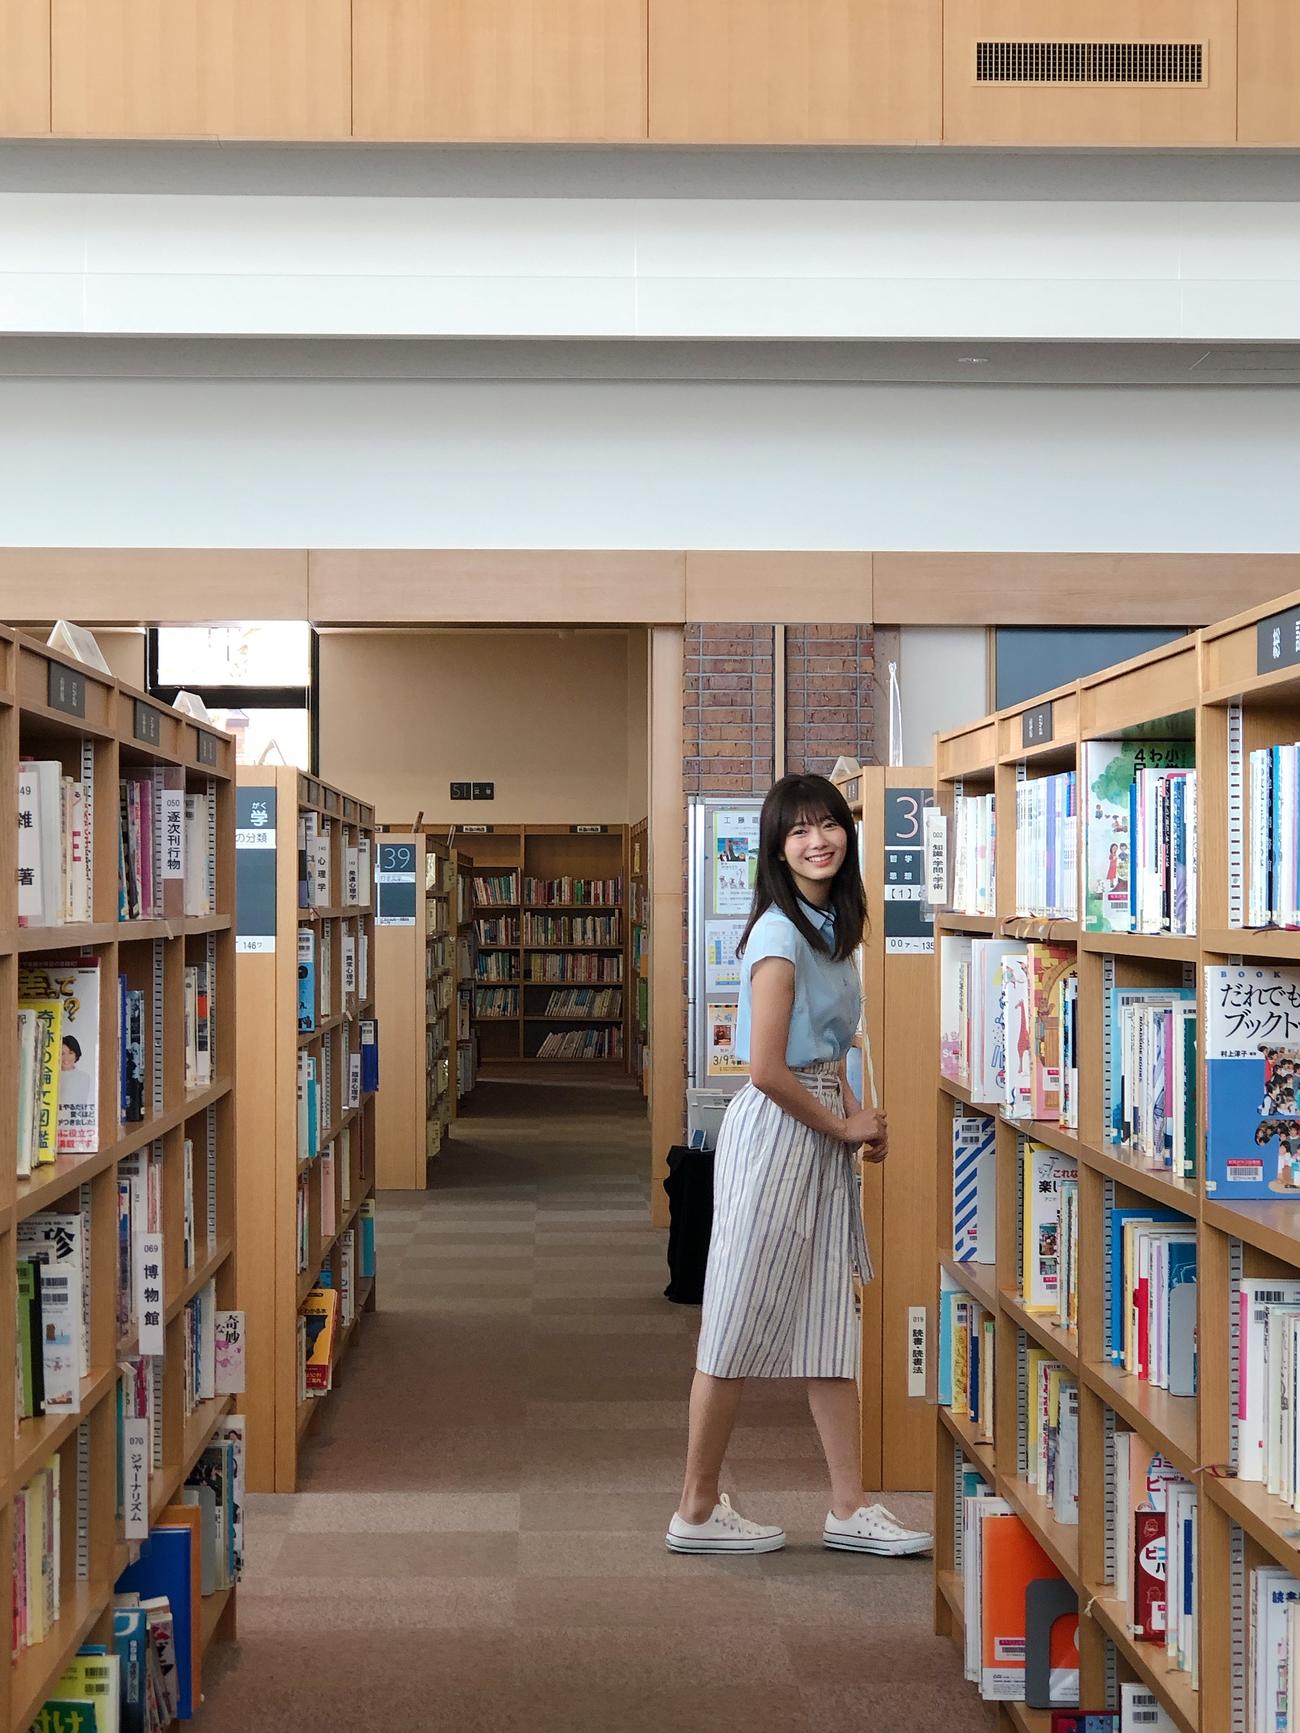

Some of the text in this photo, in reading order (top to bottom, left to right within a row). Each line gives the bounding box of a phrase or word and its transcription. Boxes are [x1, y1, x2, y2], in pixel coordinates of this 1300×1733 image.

[167, 799, 180, 807] 050
[251, 809, 268, 826] 学
[167, 811, 181, 870] 逐次刊行物
[384, 847, 411, 869] 39
[318, 857, 326, 891] 心理学
[1221, 983, 1300, 1008] だれでも
[1224, 1009, 1300, 1039] ブックト
[144, 1244, 158, 1253] 069
[144, 1264, 160, 1327] 博物館
[912, 1328, 924, 1375] 読書・読書法
[130, 1453, 142, 1522] ジャーナリズム
